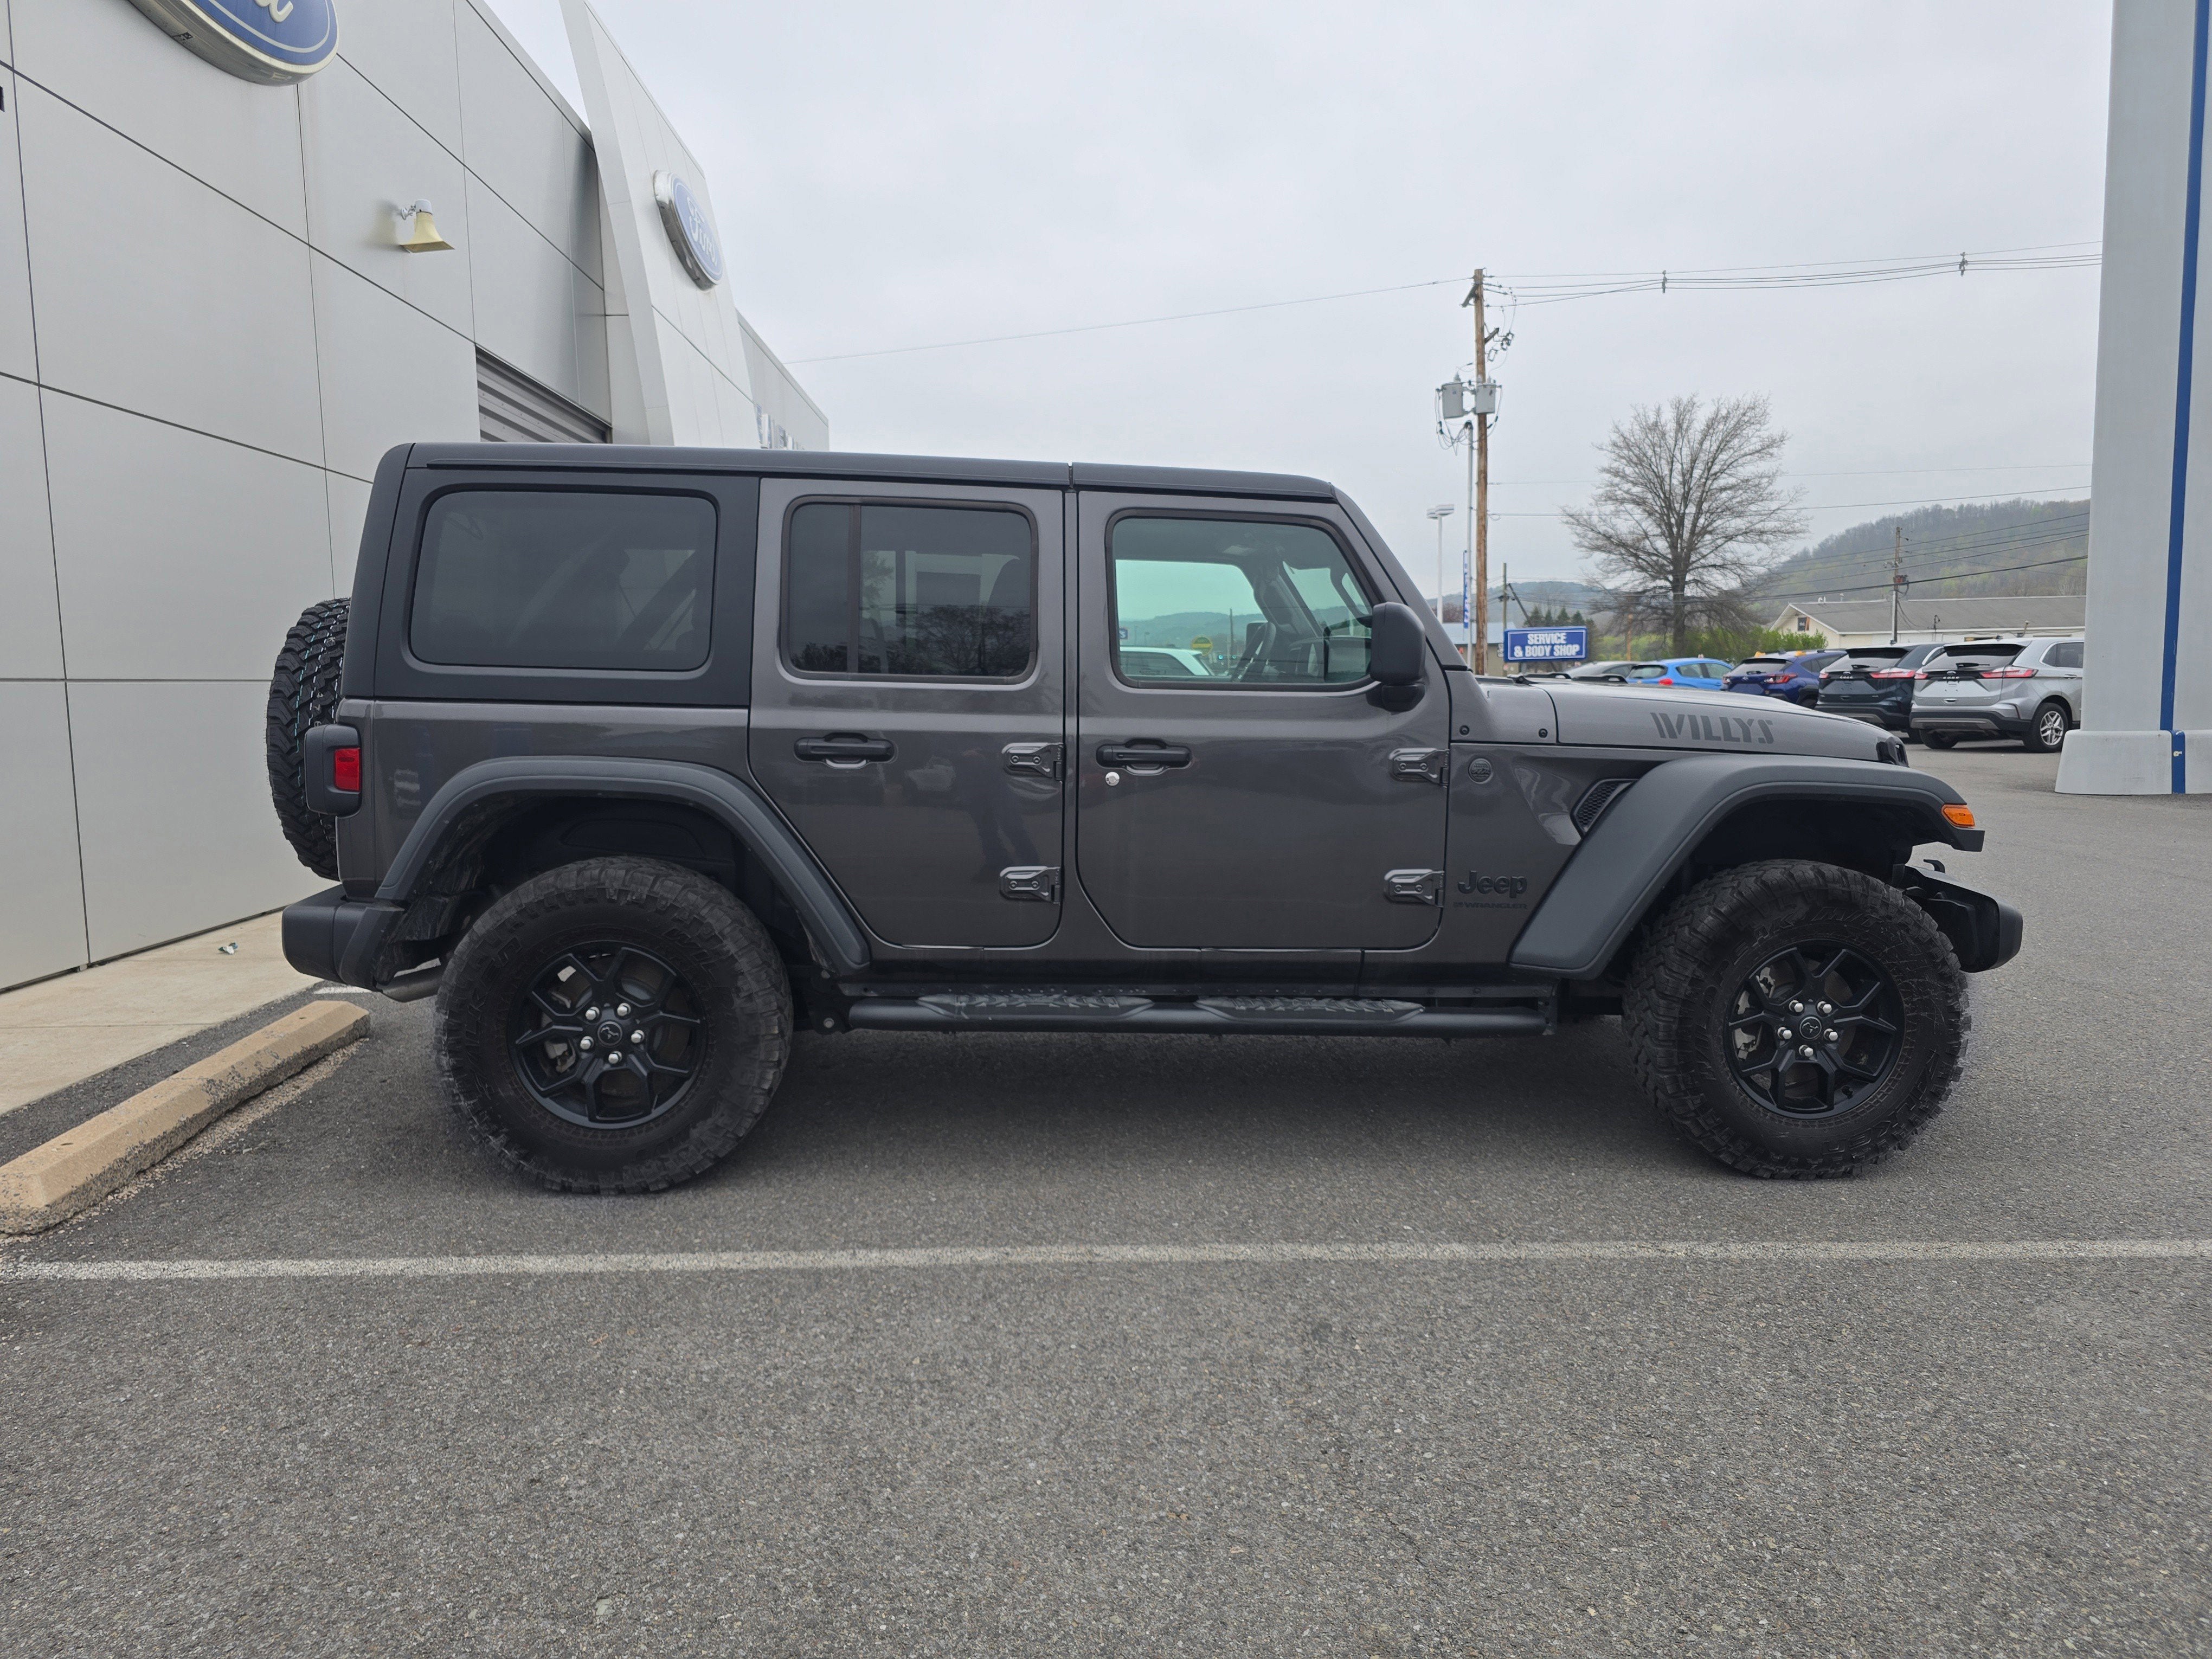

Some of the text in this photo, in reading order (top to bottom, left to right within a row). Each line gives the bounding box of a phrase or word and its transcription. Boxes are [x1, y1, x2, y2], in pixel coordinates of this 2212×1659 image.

[1527, 633, 1567, 645] SERVICE
[1514, 645, 1523, 658] &
[1525, 645, 1552, 657] BODY
[1553, 644, 1580, 657] SHOP
[1650, 712, 1774, 744] WILLYS
[1457, 870, 1527, 898] Jeep
